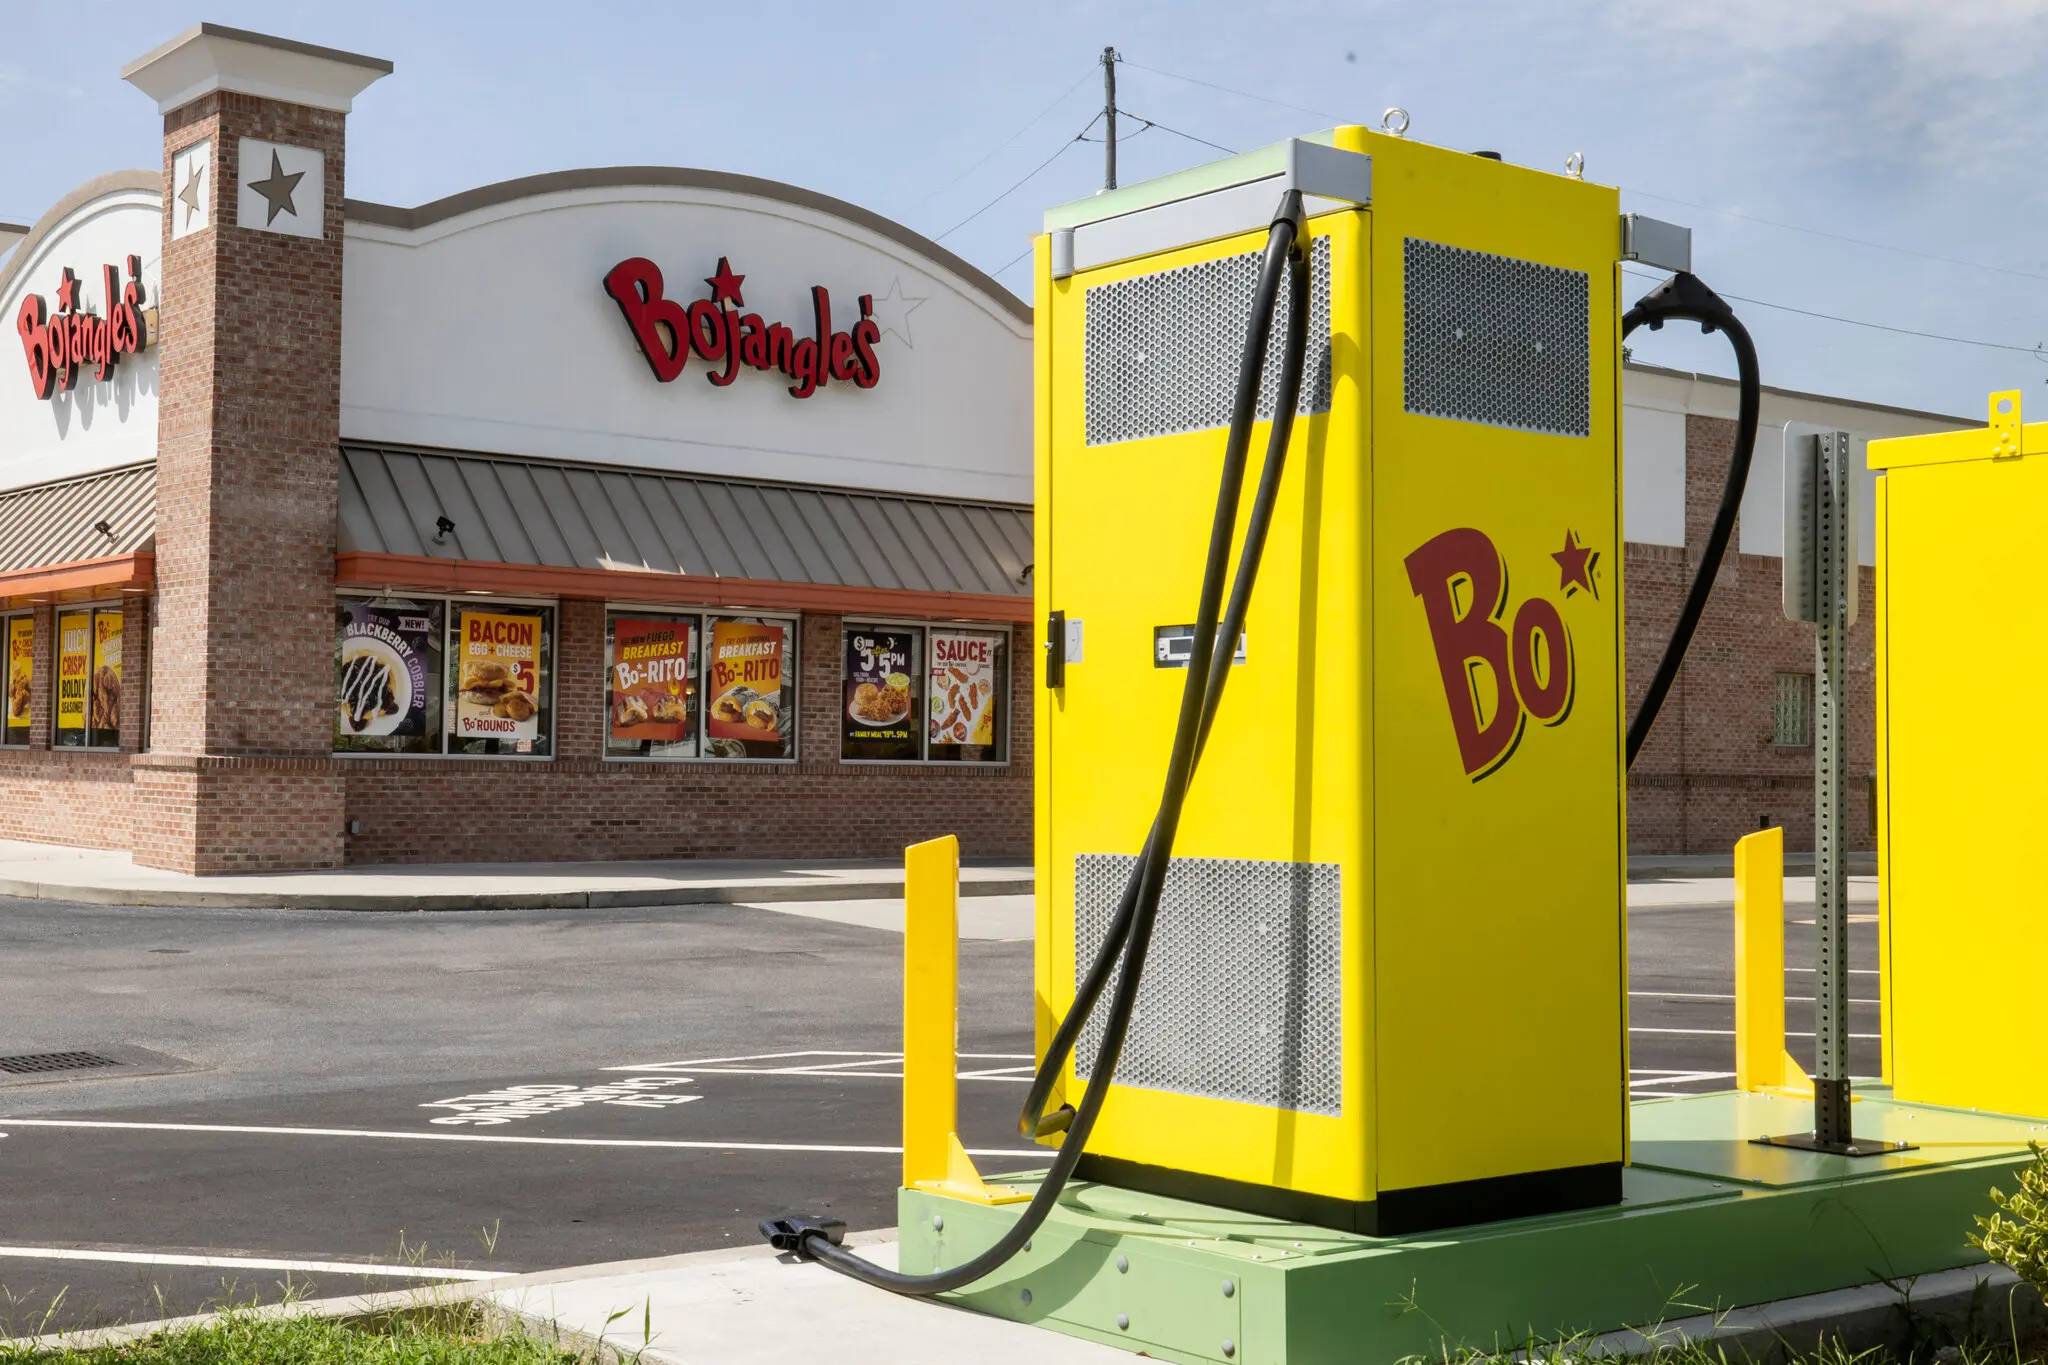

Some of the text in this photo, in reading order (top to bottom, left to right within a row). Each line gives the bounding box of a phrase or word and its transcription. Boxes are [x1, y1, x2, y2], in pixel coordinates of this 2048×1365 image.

[405, 619, 425, 629] NEW!
[469, 619, 533, 646] BACON
[64, 628, 88, 653] JUICY
[647, 630, 675, 642] FUEGO
[468, 644, 488, 656] EGG
[496, 645, 532, 657] CHEESE
[622, 641, 684, 660] BREAKFAST
[719, 641, 777, 659] BREAKFAST
[936, 639, 987, 662] SAUCE
[1403, 527, 1576, 784] Bo
[62, 656, 87, 675] CRISPY
[346, 622, 425, 709] BLACKBERRY COBBLER
[62, 679, 87, 698] BOLDLY
[61, 701, 83, 713] SEASONED
[476, 719, 515, 732] ROUNDS
[418, 1084, 579, 1112] ONLY
[429, 1077, 695, 1126] CHARGING
[603, 1093, 704, 1109] EV
